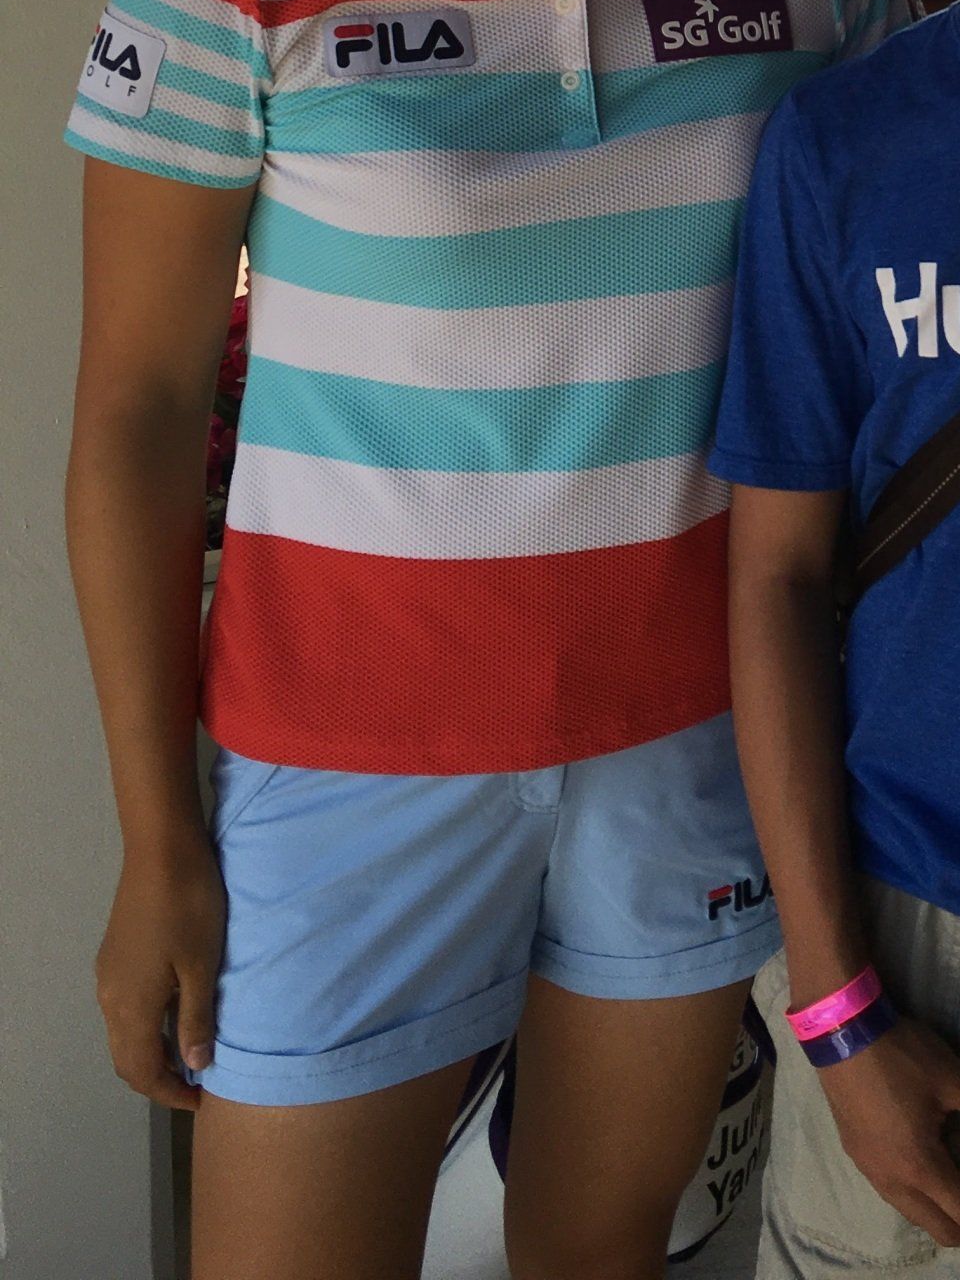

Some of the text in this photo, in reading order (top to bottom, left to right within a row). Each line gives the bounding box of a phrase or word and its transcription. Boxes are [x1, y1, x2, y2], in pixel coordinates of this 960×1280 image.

[91, 24, 142, 81] ILA
[334, 18, 465, 69] FILA
[660, 10, 782, 50] SG Golf
[86, 64, 137, 97] OLF
[707, 872, 774, 921] FIL
